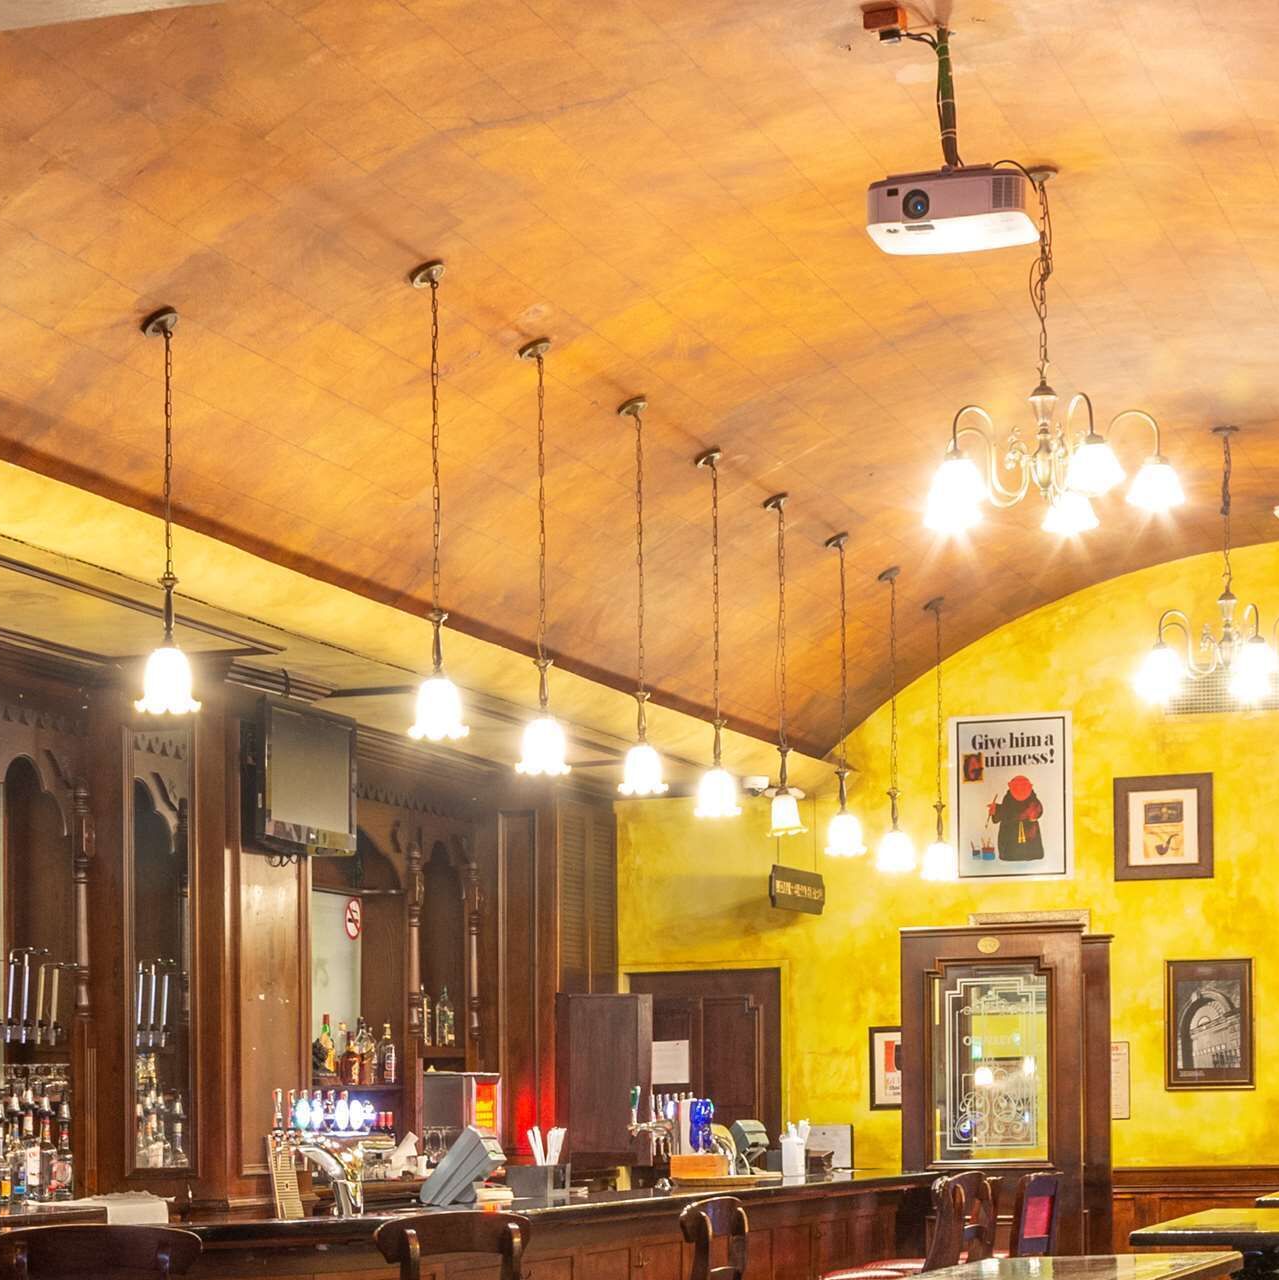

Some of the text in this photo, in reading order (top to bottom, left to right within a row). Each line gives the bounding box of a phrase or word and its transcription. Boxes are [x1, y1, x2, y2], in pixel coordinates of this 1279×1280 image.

[971, 732, 1054, 750] Give him a
[962, 748, 1055, 782] Guinness!
